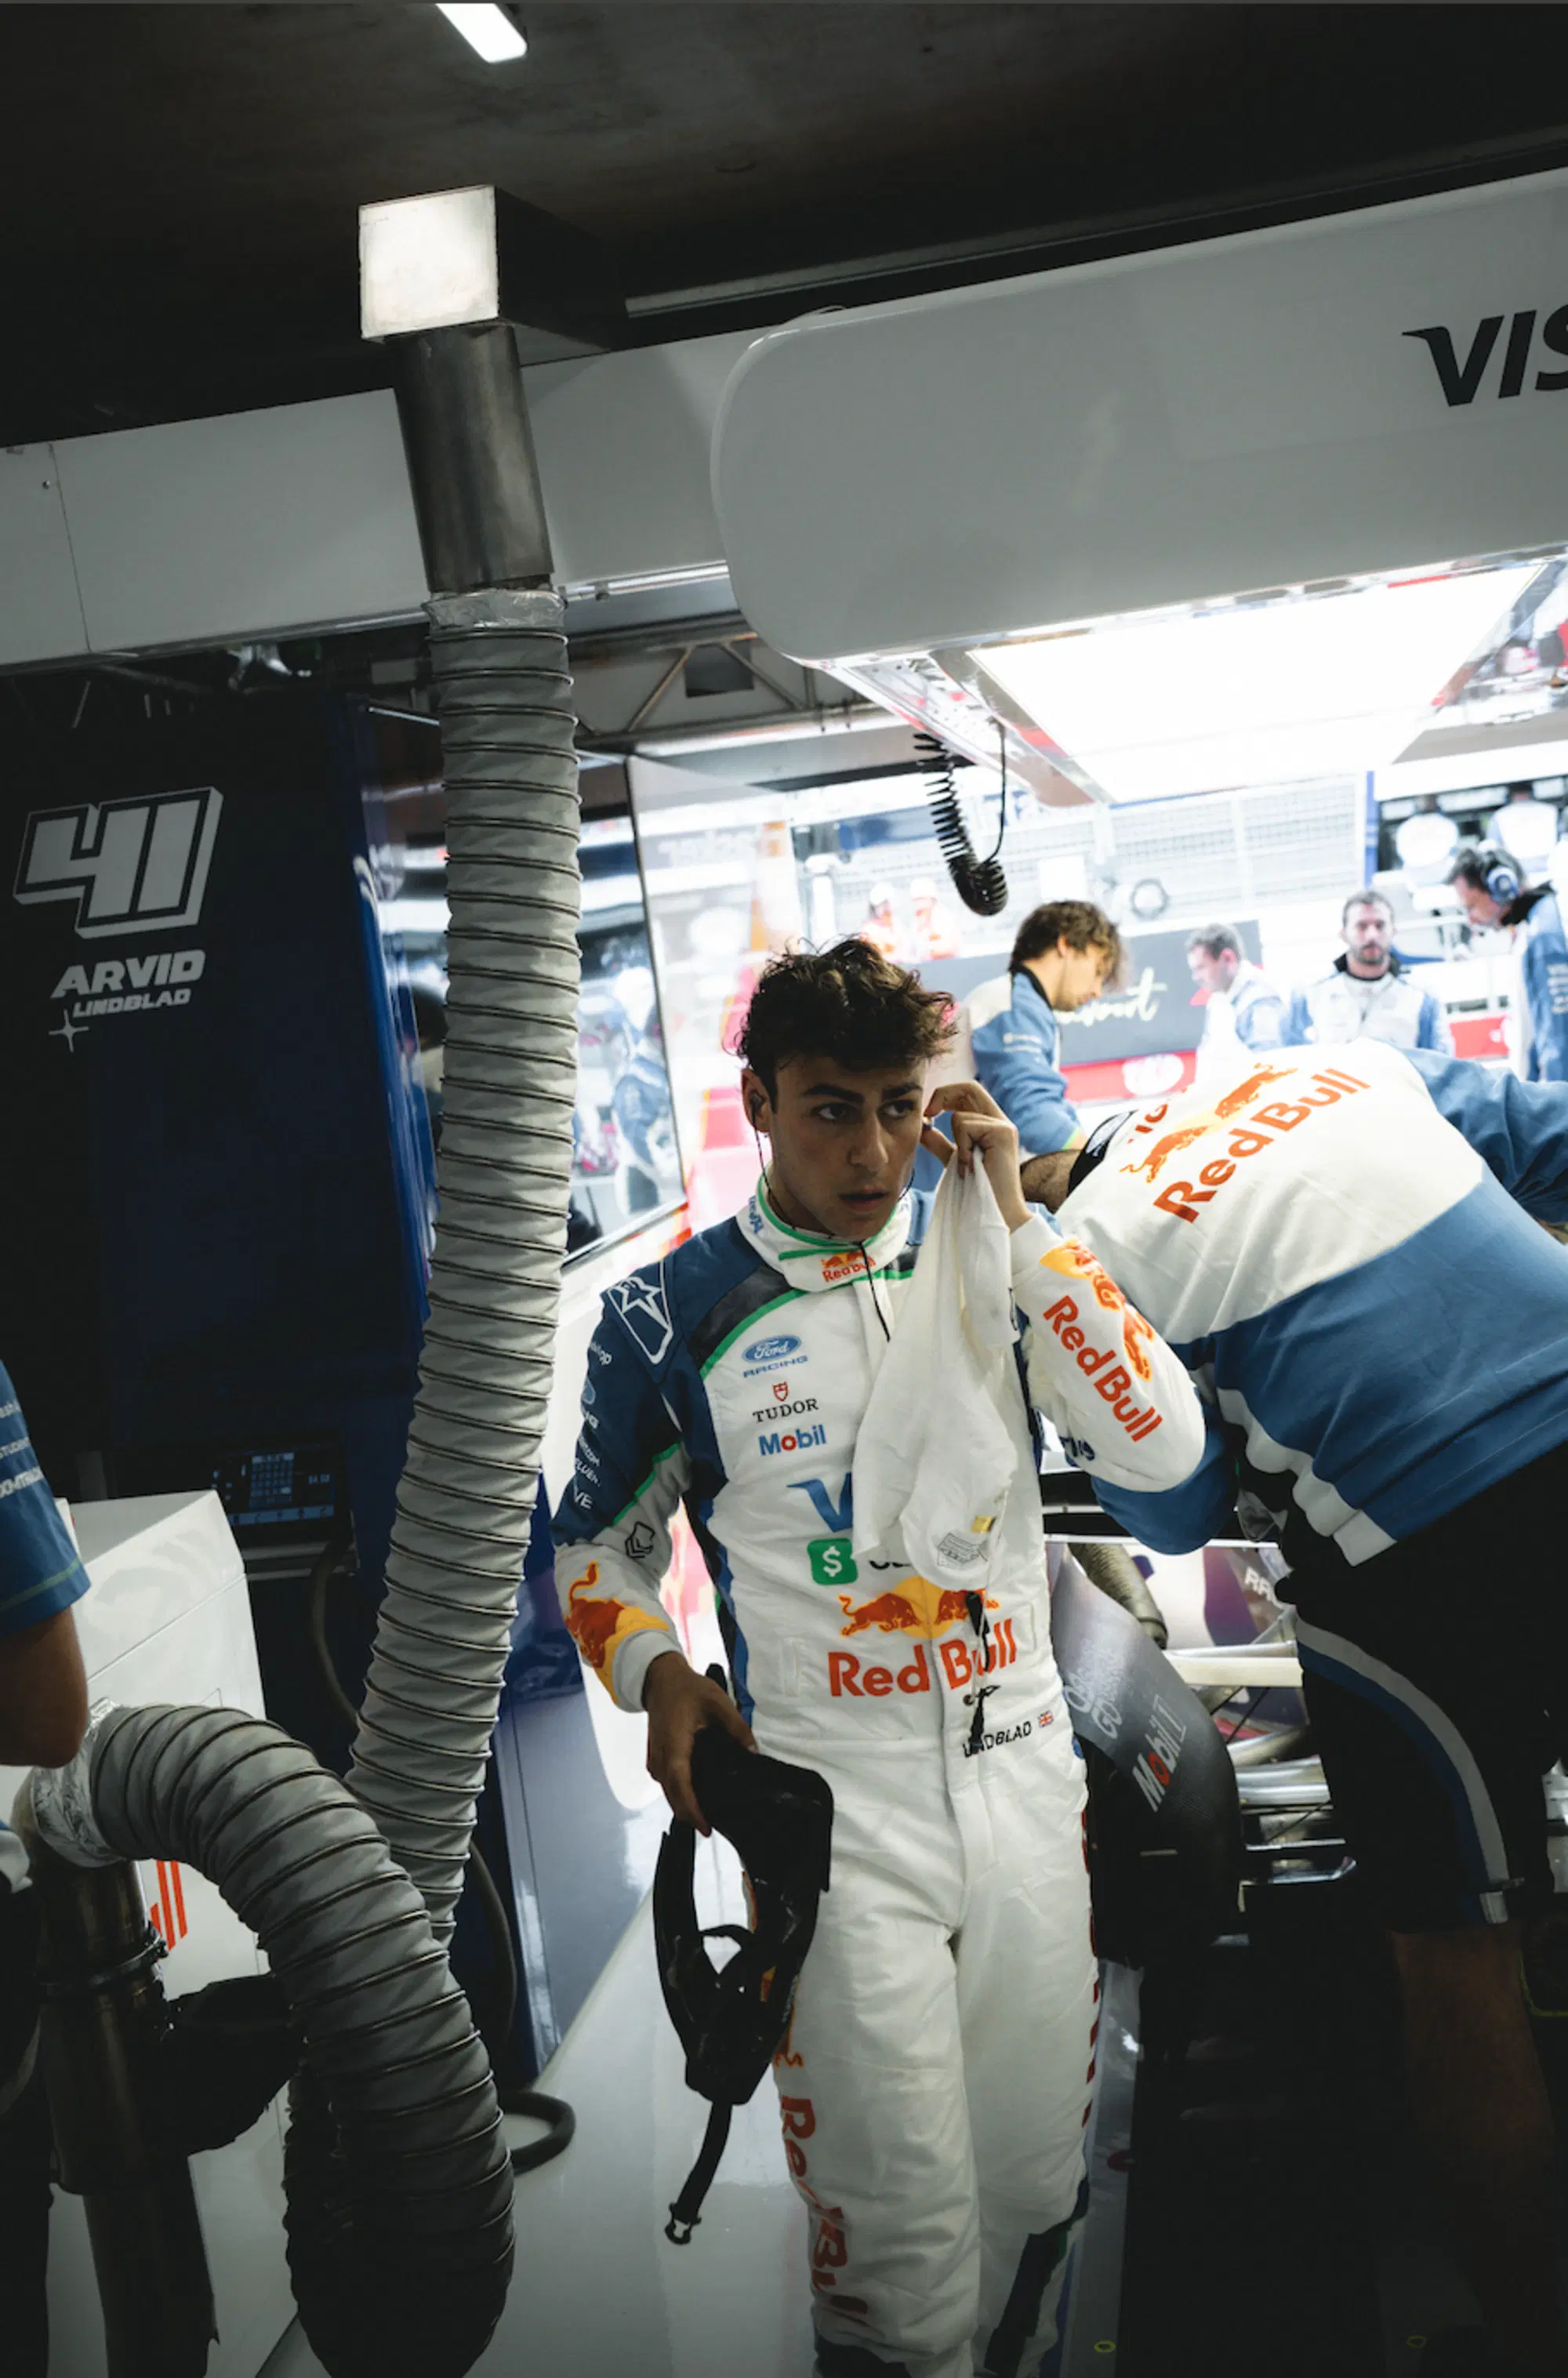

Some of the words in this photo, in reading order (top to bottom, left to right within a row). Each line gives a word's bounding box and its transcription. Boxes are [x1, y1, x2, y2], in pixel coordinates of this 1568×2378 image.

[13, 786, 224, 939] 41
[50, 949, 206, 1000] ARVID
[73, 988, 191, 1018] LINDBLAD
[1152, 1127, 1275, 1224] Red
[1249, 1067, 1372, 1132] Bull
[742, 1355, 809, 1378] RACING
[753, 1339, 789, 1360] Ford
[1043, 1294, 1117, 1378] Red
[1093, 1364, 1163, 1443] Bull
[752, 1398, 819, 1423] TUDOR
[758, 1424, 827, 1457] Mobil
[828, 1643, 931, 1697] Red
[962, 1720, 1033, 1759] LDBLAD
[1132, 1715, 1183, 1813] Mobil
